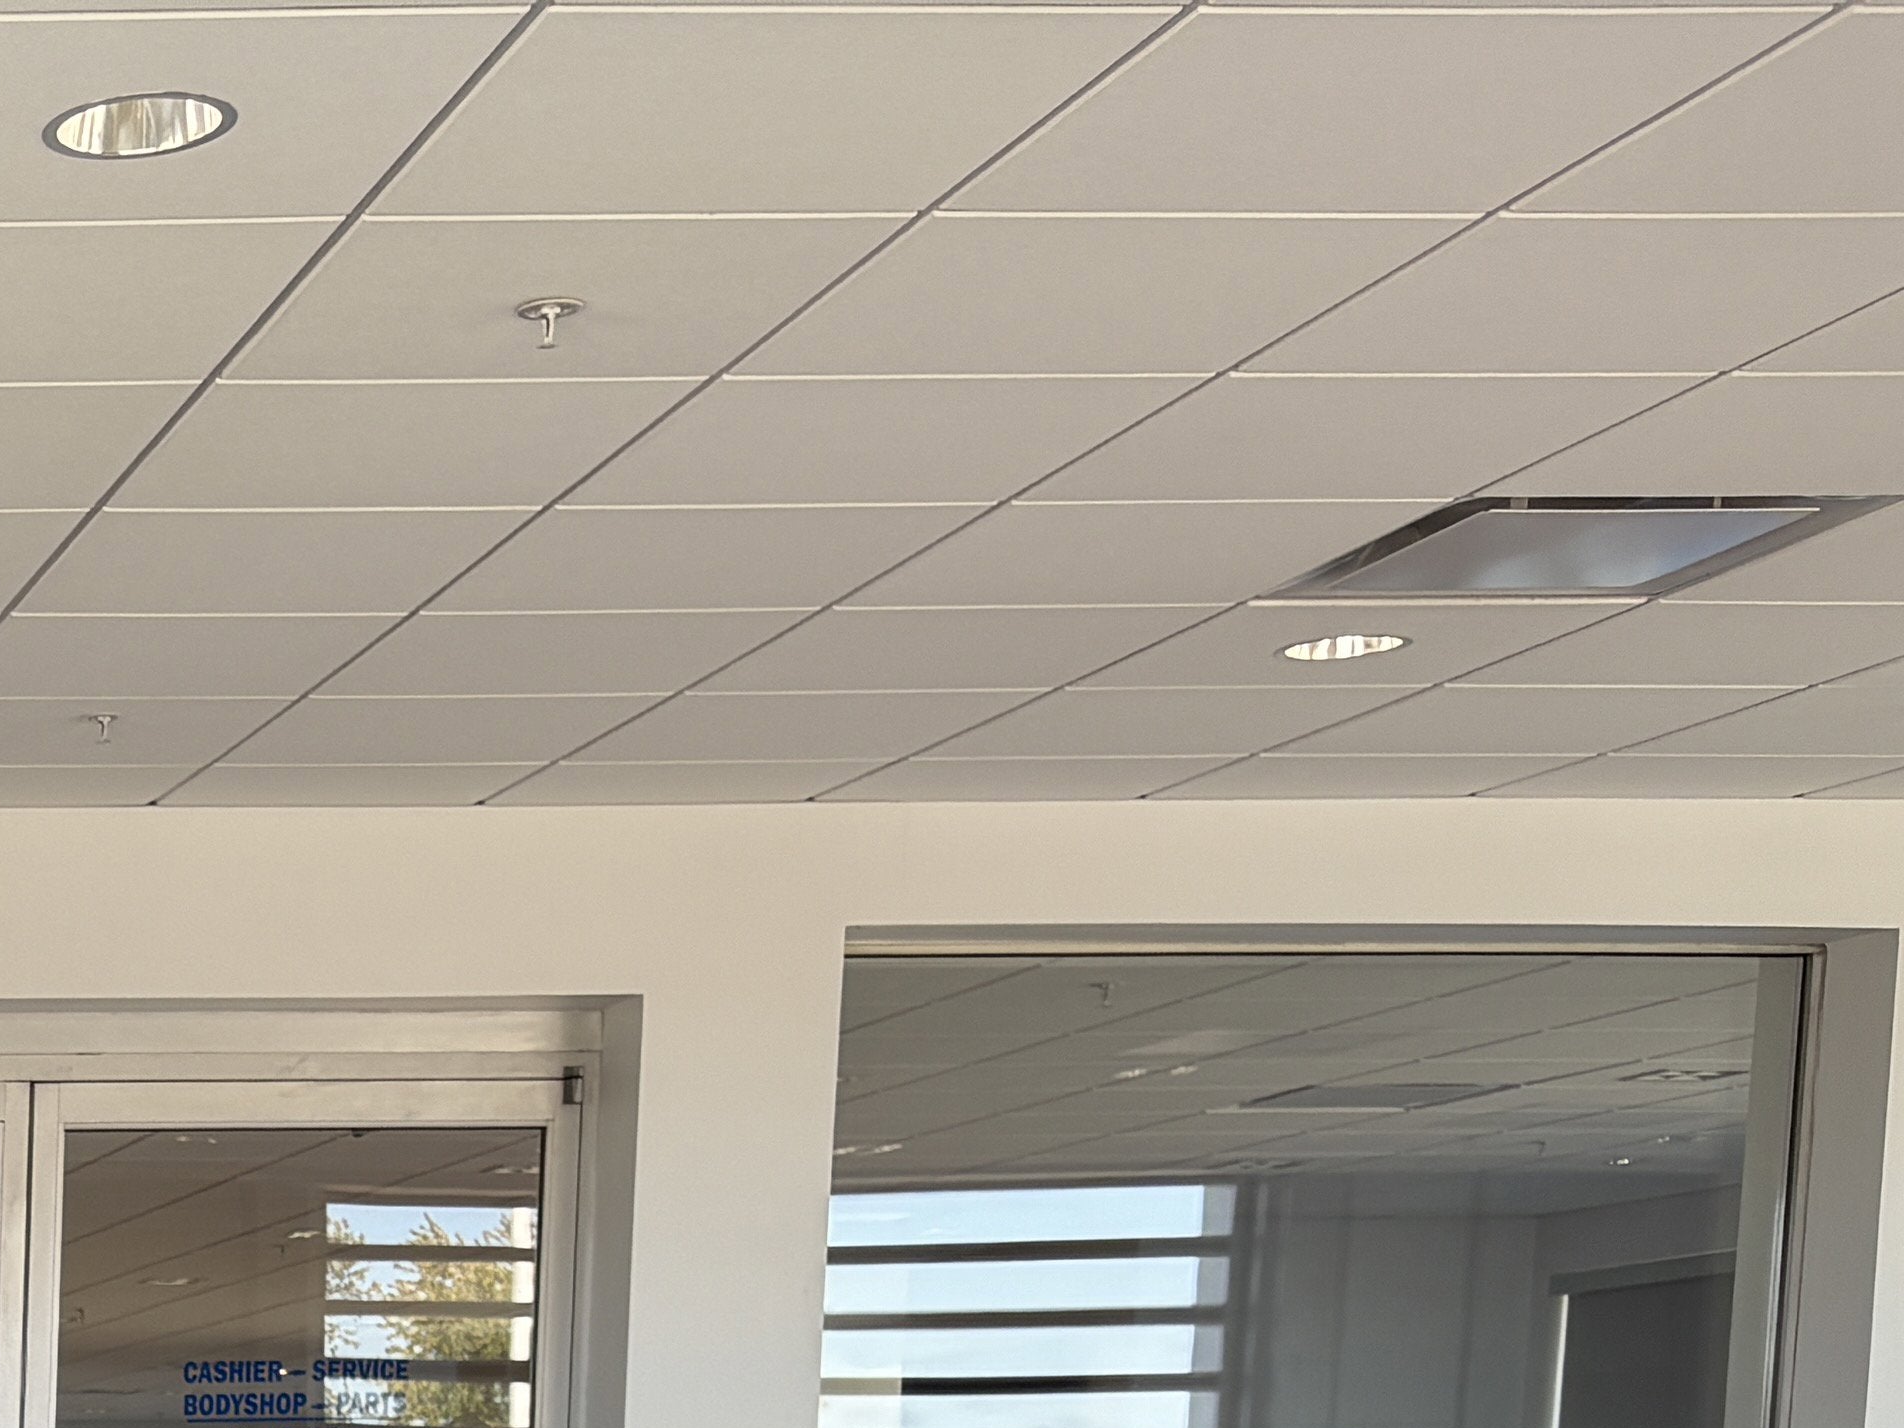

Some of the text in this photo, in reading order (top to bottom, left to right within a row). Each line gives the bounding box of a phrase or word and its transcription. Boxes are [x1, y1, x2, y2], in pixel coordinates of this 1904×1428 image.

[183, 1359, 409, 1384] CASHIER SERVICE
[184, 1392, 407, 1416] BODYSHOP PARTS
